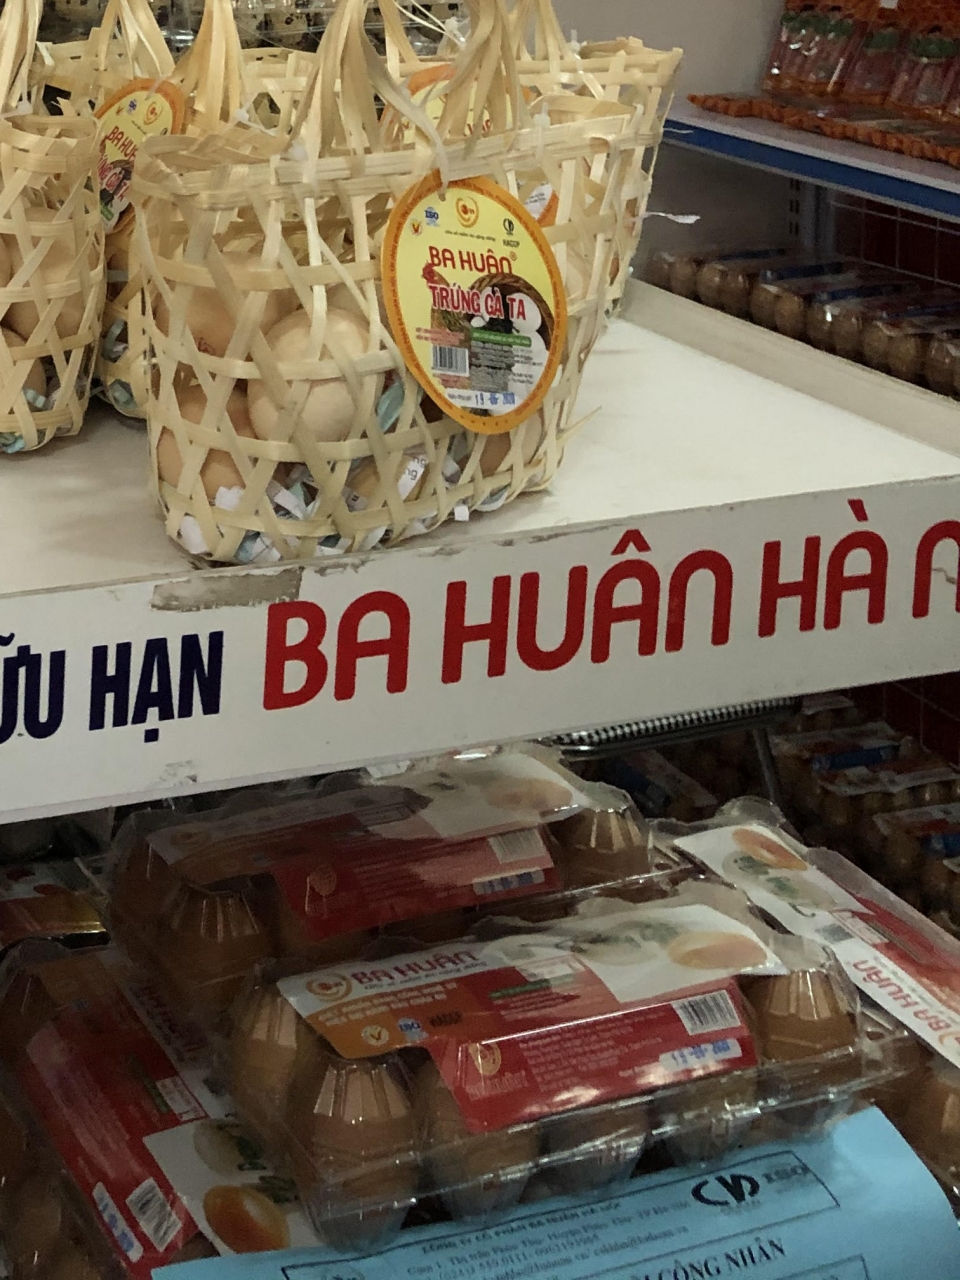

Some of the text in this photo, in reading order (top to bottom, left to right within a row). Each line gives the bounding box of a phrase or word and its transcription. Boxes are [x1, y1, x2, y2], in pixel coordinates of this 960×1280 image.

[428, 246, 513, 274] BA HUÂN
[428, 282, 527, 321] TRỨNG GÀ TA
[89, 630, 224, 743] HẠN
[262, 590, 411, 711] BA
[441, 529, 734, 684] HUÂN
[757, 498, 889, 638] HÀ
[351, 969, 395, 985] BA
